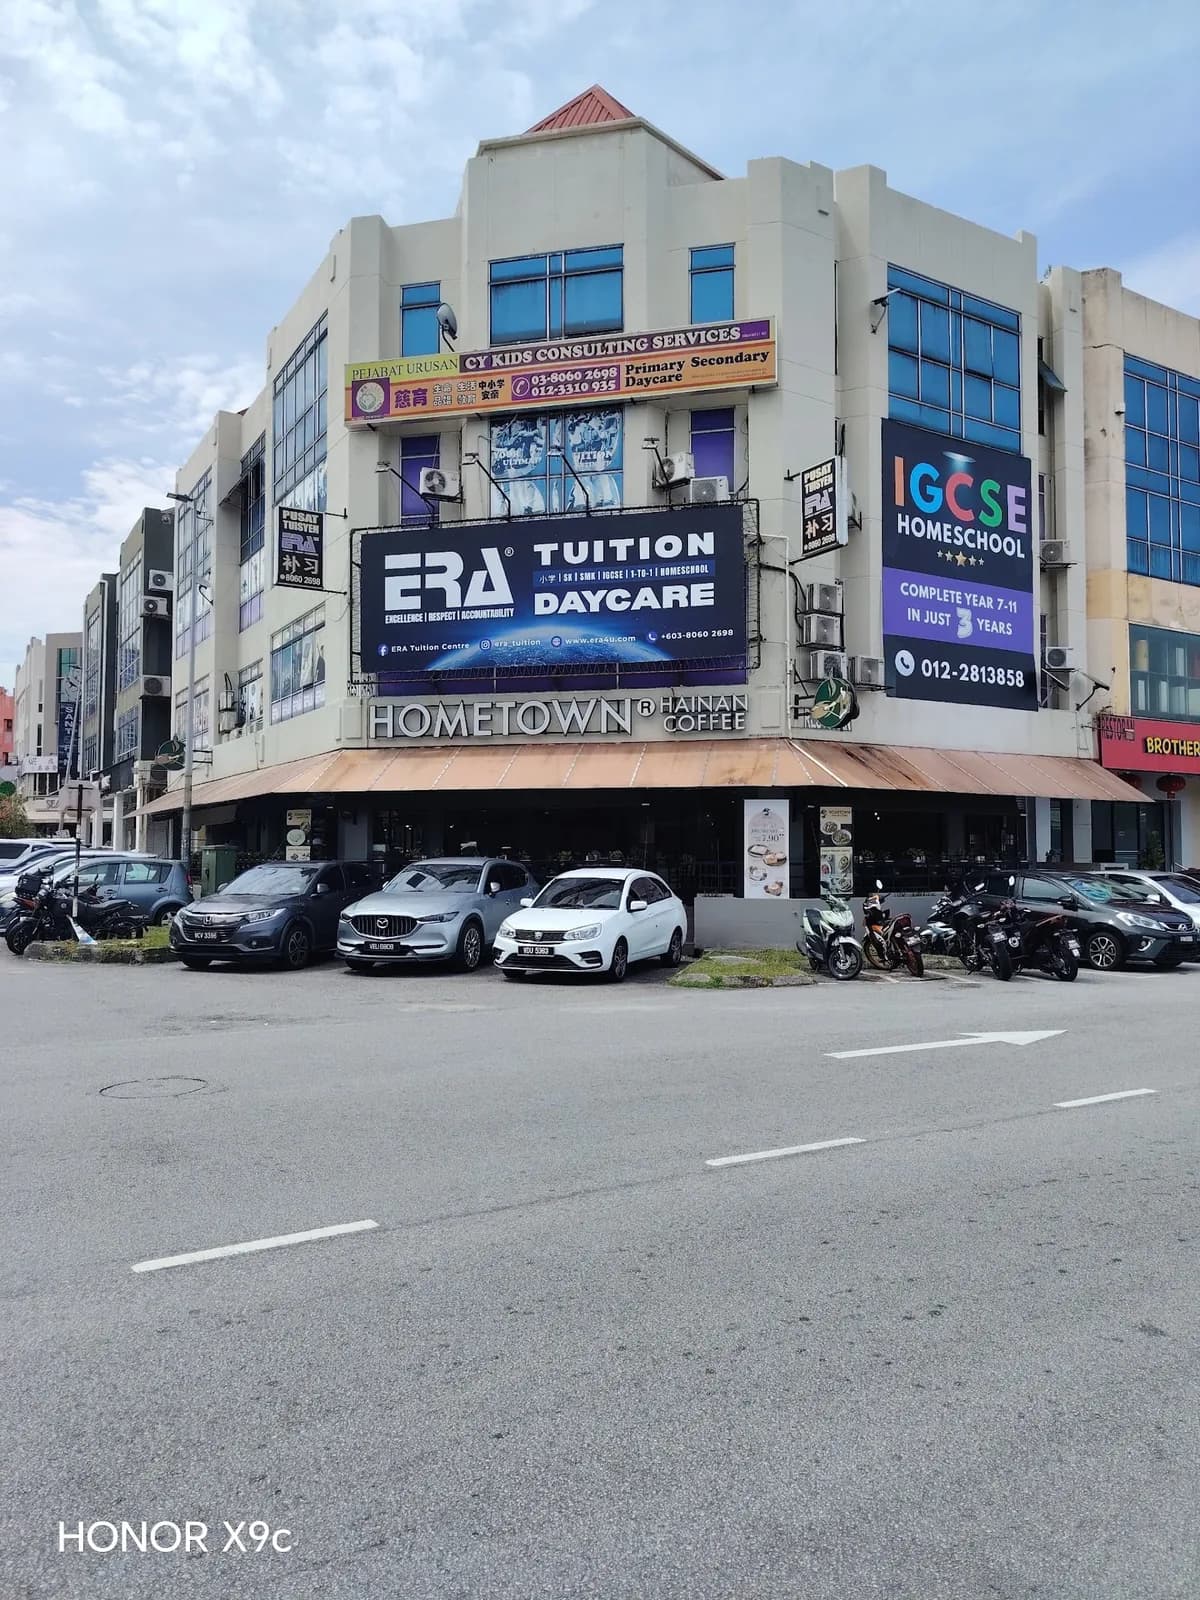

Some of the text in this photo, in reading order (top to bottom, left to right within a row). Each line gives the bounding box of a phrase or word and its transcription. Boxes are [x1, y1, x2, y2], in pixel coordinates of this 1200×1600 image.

[464, 326, 741, 370] CY KIDS CONSULTING SERVICES
[352, 359, 458, 379] PEJABAT URUSAN
[625, 359, 686, 376] Primary
[691, 350, 770, 368] Secondary
[531, 366, 618, 385] 03-8060 2698
[625, 372, 683, 388] Daycare
[531, 379, 616, 397] 012-3310 935
[804, 462, 833, 484] PUSAT
[894, 455, 1027, 534] IGCSE
[282, 509, 319, 524] PUSAT
[805, 512, 833, 539] 补习
[897, 512, 1026, 559] HOMESCHOOL
[533, 532, 715, 566] TUITION
[282, 554, 319, 575] 补习
[539, 563, 709, 584] 小学 SK SMK IGCSE 1-TO-1 HOMESCHOOL
[534, 582, 715, 616] DAYCARE
[900, 582, 1018, 614] COMPLETE YEAR 7-11
[384, 607, 515, 625] EXCELLENCE RESPECT ACCOUNTABILITY
[907, 607, 1014, 639] IN JUST 3 YEARS
[565, 635, 637, 646] www.era4u.com
[660, 628, 735, 641] +603-8060 2698
[391, 642, 470, 654] ERA Tuition Centre
[921, 658, 1026, 689] 012-2813858
[660, 694, 749, 713] HAINAN
[663, 712, 746, 733] COFFEE
